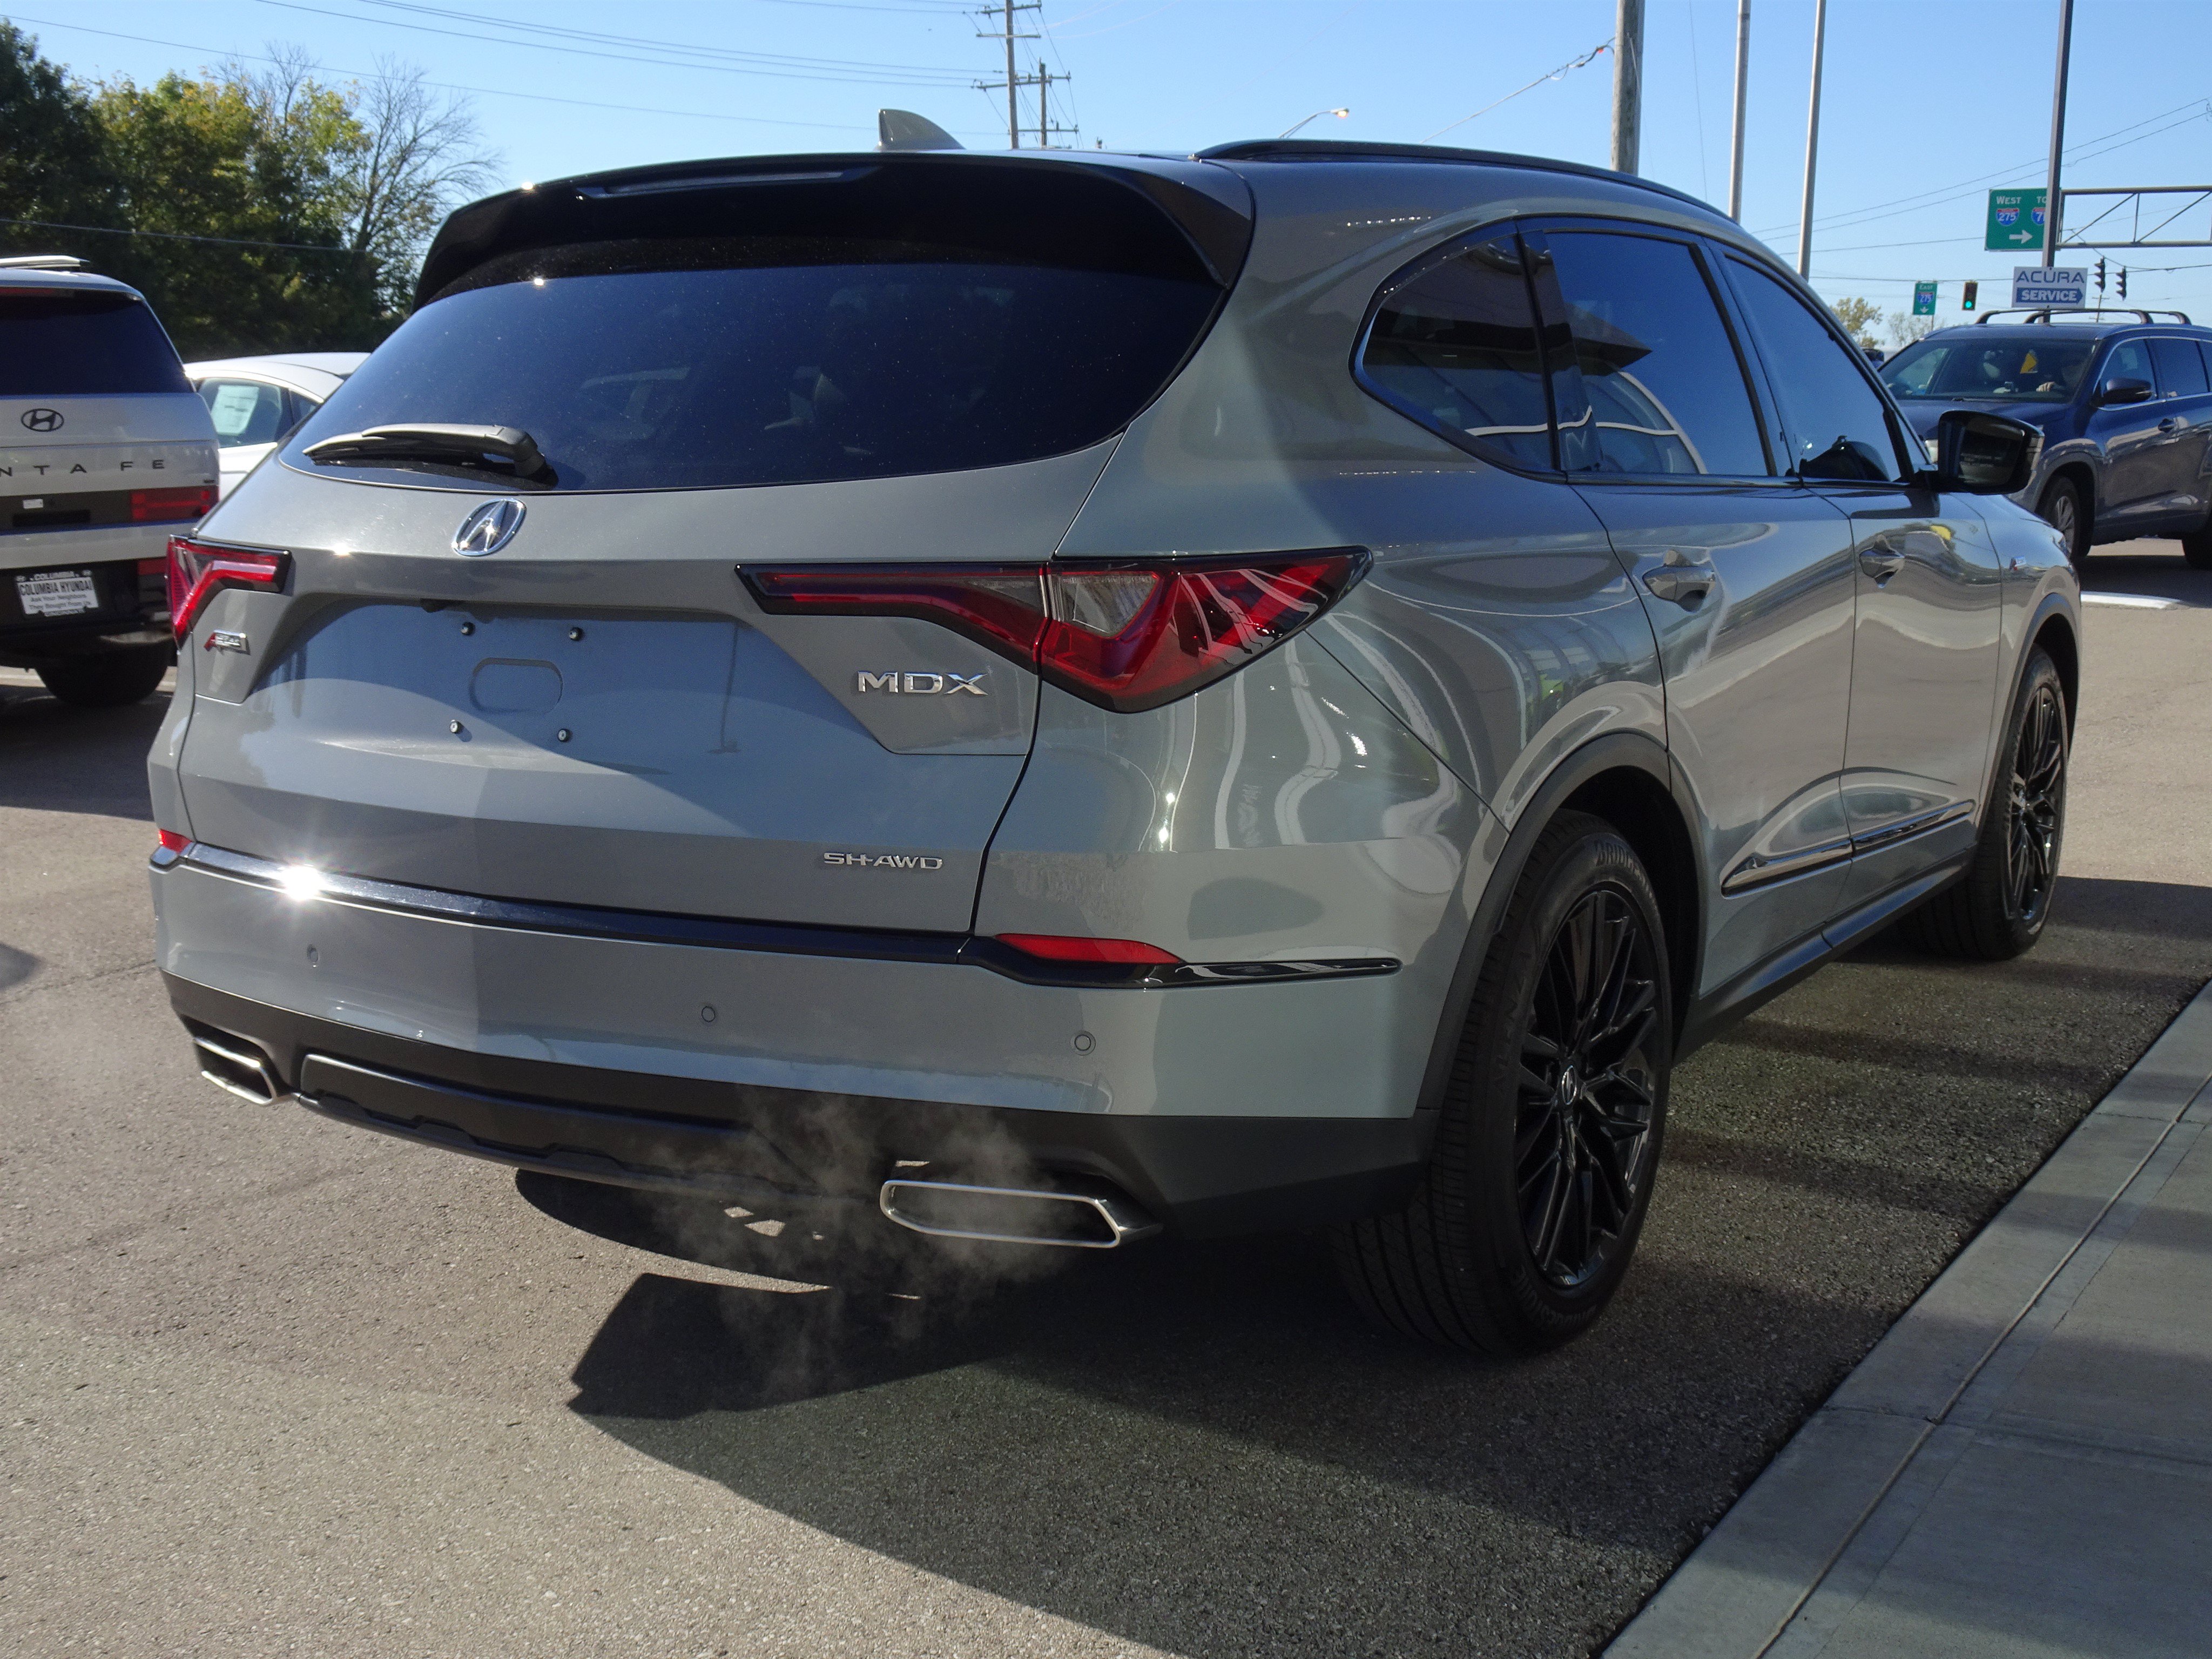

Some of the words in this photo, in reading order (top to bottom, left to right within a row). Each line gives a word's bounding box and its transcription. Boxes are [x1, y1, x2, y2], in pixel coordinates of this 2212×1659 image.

[1996, 196, 2021, 204] WEST
[1998, 212, 2016, 221] 275
[2016, 271, 2085, 283] ACURA
[1919, 294, 1932, 302] 275
[2021, 289, 2078, 301] SERVICE
[120, 459, 165, 471] FE
[19, 582, 59, 596] COLUMBIA
[59, 579, 93, 592] HYUNDAI
[858, 671, 988, 696] MDX
[824, 852, 943, 869] SH-AWD
